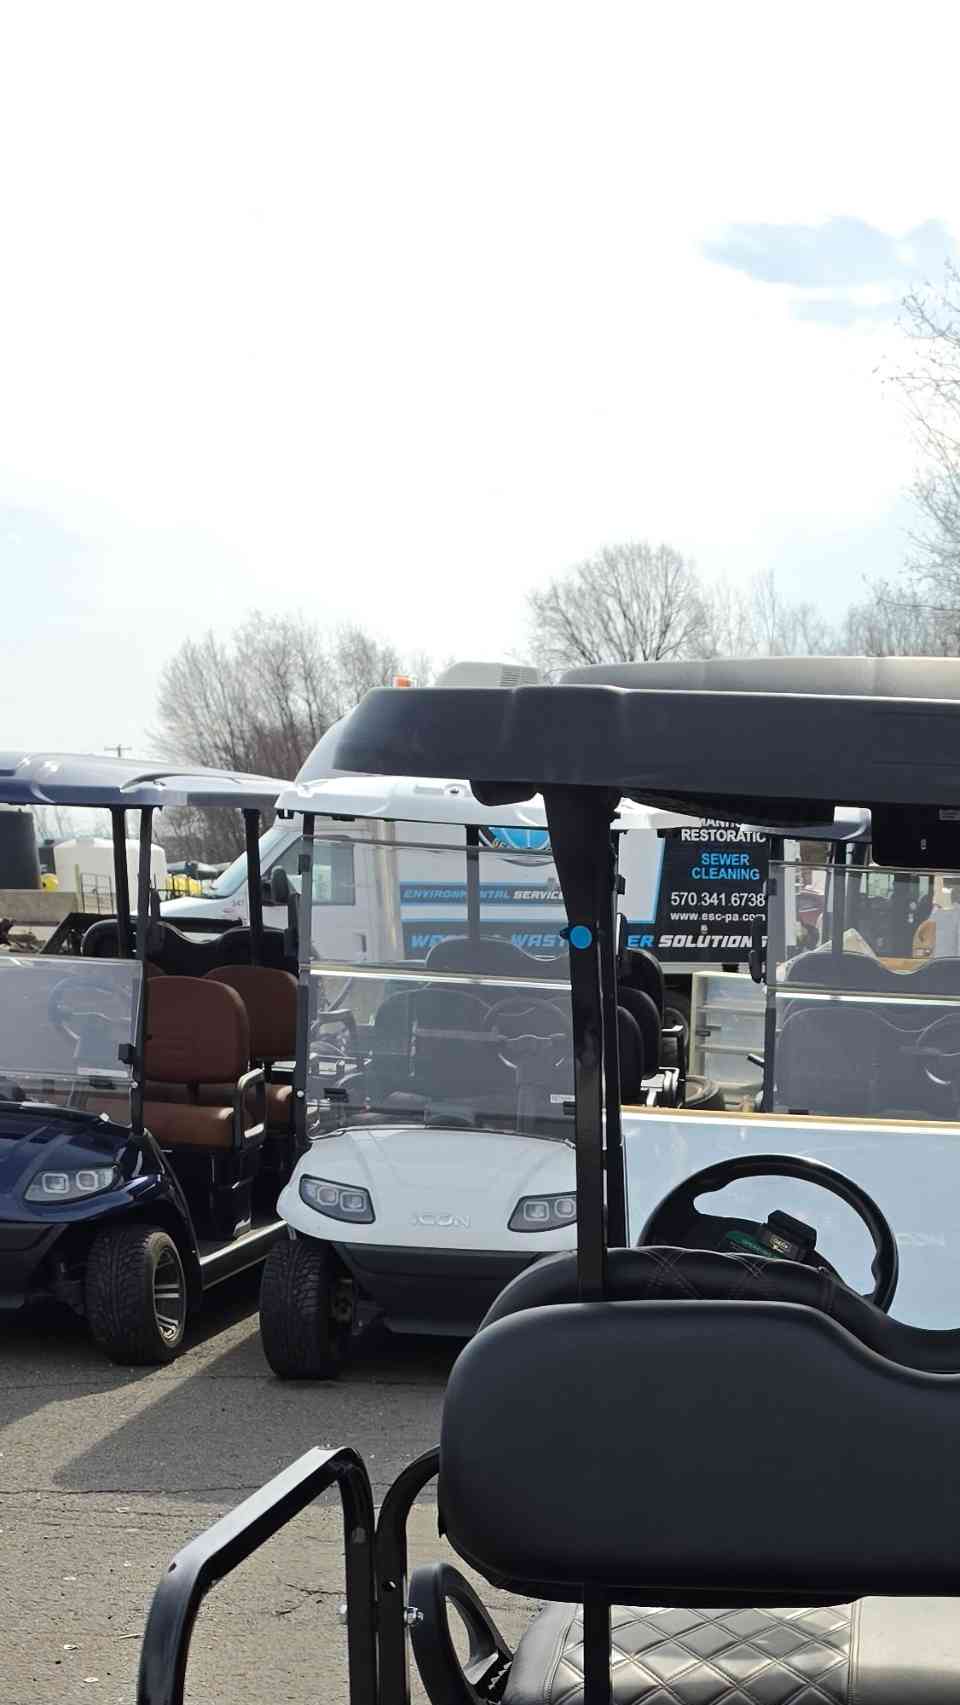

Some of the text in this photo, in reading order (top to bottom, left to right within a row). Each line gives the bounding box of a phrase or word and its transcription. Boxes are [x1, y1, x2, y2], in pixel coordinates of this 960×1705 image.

[681, 829, 766, 842] RESTORATIO
[702, 853, 750, 865] SEWER
[692, 867, 760, 880] CLEANING
[671, 891, 766, 907] 570.341.6738
